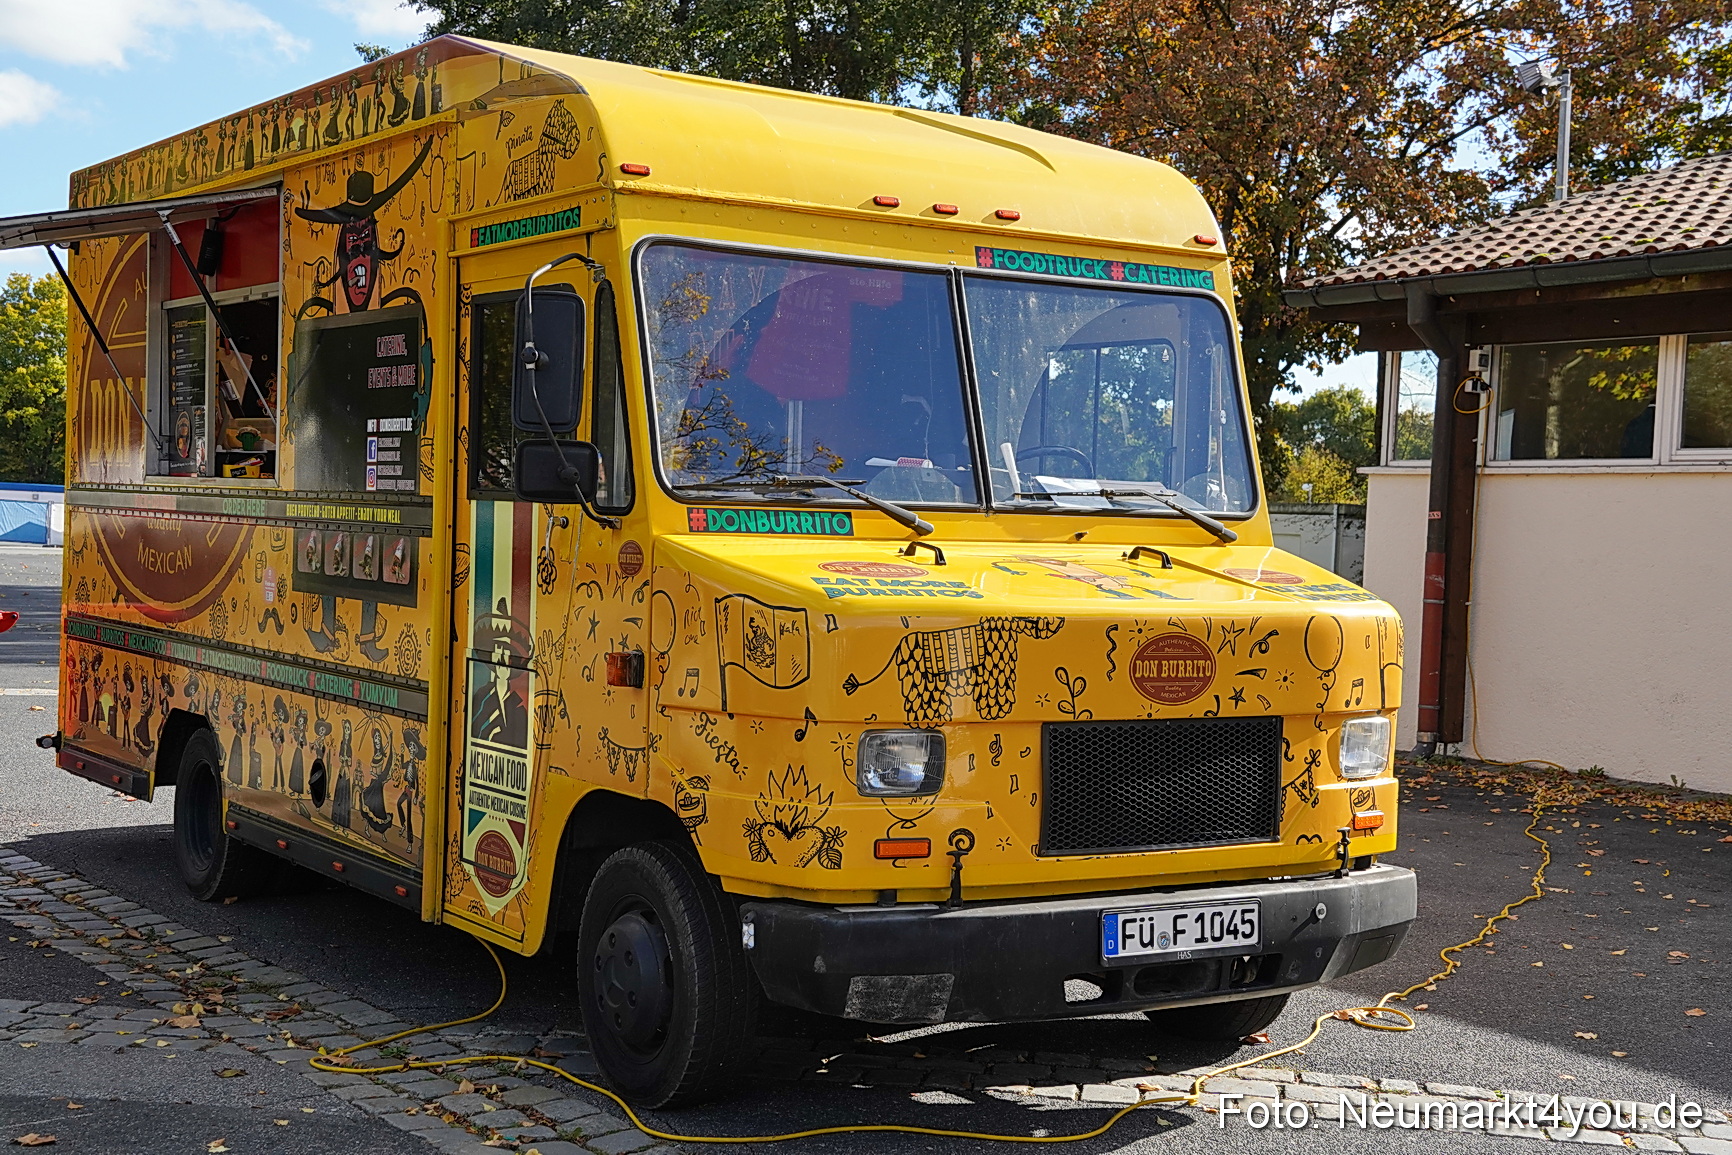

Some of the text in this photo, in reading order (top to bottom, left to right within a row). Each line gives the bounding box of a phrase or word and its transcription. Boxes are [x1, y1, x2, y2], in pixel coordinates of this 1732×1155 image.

[471, 208, 580, 247] #EATMOREBURRITOS
[978, 247, 1214, 290] #FOODTRUCK #CATERING
[367, 366, 391, 389] EVENTS
[398, 364, 416, 387] MORE
[89, 377, 133, 467] DON
[222, 499, 266, 517] ORDER HERE
[689, 508, 851, 534] #DONBURRITO
[137, 542, 193, 575] MEXICAN
[810, 576, 971, 589] EAT MORE
[822, 586, 985, 600] BURRITOS
[1159, 639, 1192, 647] AUTHENTIC
[1135, 660, 1212, 678] DON BURRITO
[261, 661, 308, 688] #FOODTRUCK
[309, 671, 353, 697] #CATERING
[353, 680, 399, 708] #YUMYUM
[694, 711, 741, 774] Fiesta
[469, 750, 528, 792] MEXICAN FOOD
[468, 789, 490, 809] AUTHENTIC
[490, 796, 509, 815] MEXICAN
[1121, 908, 1256, 950] FÜ F 1045
[1107, 939, 1115, 950] D
